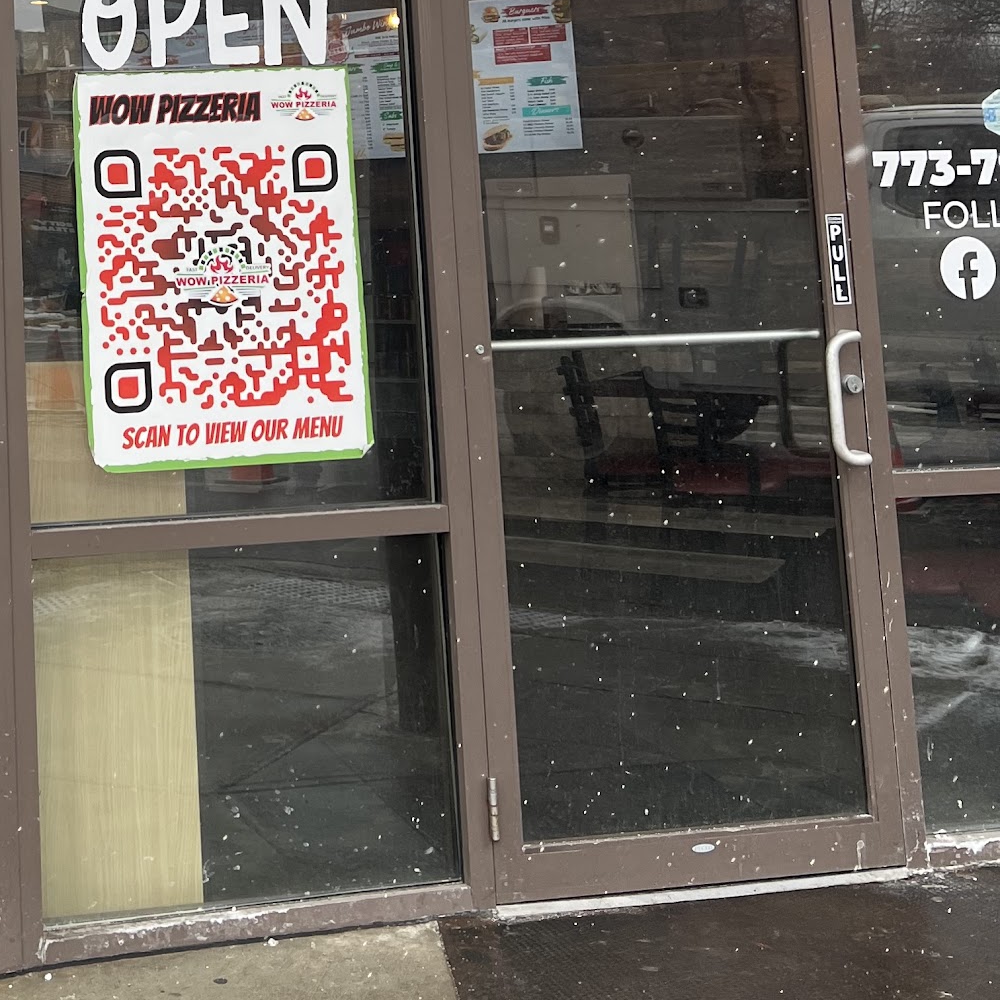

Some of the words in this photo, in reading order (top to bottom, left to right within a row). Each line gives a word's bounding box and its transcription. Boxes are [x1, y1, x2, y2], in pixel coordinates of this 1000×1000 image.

[88, 93, 155, 127] WOW
[156, 91, 262, 125] PIZZERIA
[271, 101, 293, 109] WOW
[296, 100, 337, 108] PIZZERIA
[872, 148, 1000, 187] 773-7
[923, 200, 1000, 230] FOLL
[829, 224, 849, 302] PULL
[176, 277, 207, 286] WOW
[211, 275, 269, 285] PIZZERIA
[122, 424, 171, 449] SCAN
[177, 423, 200, 446] TO
[205, 420, 246, 444] VIEW
[251, 417, 288, 440] OUR
[292, 415, 344, 439] MENU
